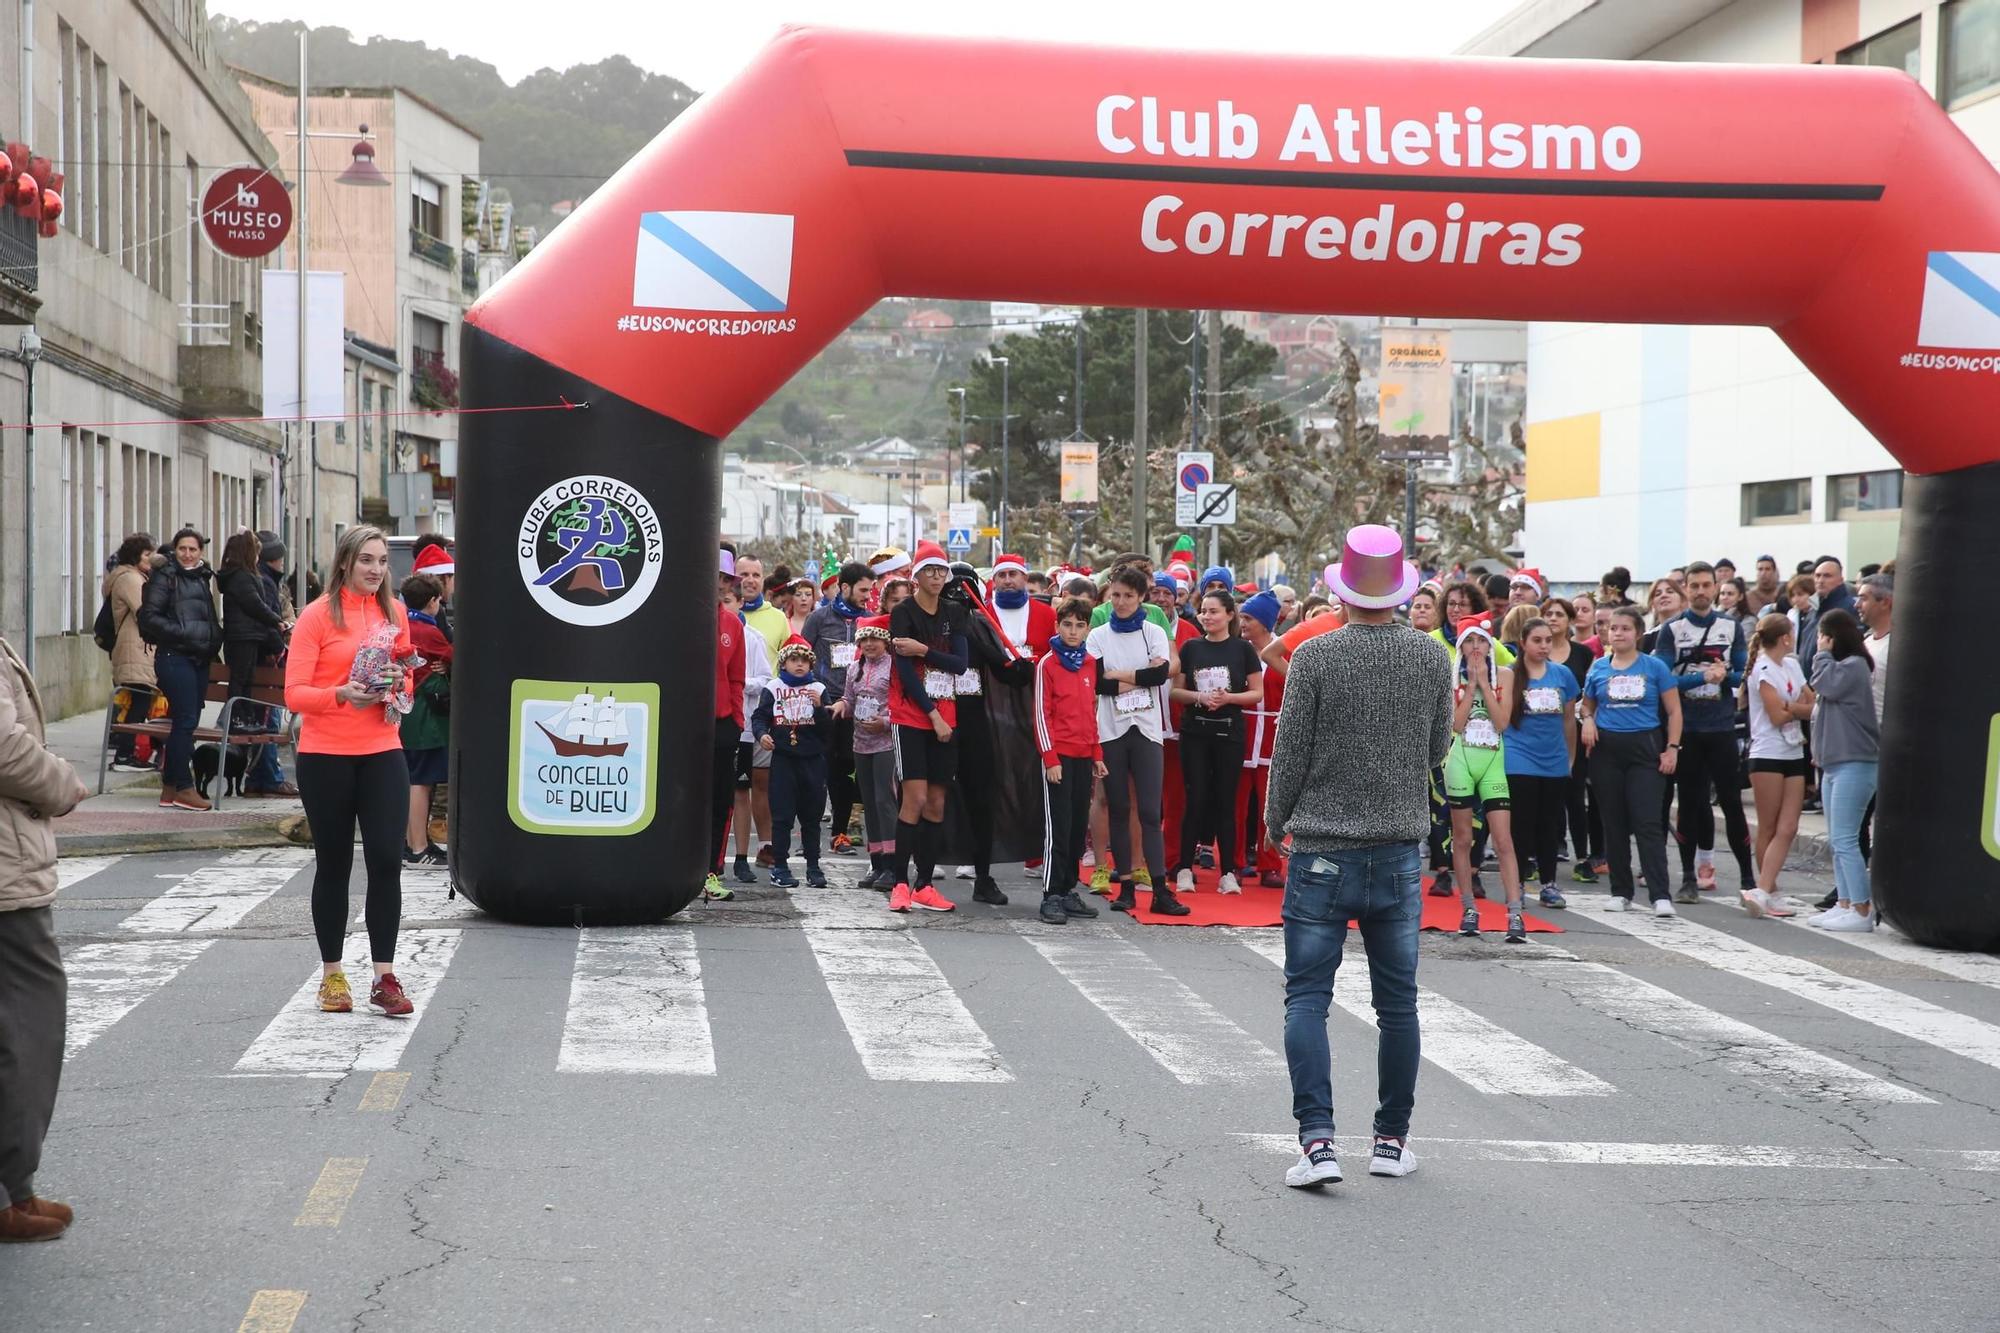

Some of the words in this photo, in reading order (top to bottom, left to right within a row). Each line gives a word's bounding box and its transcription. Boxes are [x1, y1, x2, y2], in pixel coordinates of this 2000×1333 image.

[1096, 94, 1259, 160] Club
[1278, 103, 1642, 172] Atletismo
[213, 210, 282, 228] MUSEO
[1140, 195, 1585, 267] Corredoiras
[617, 314, 797, 337] #EUSONCORREDOIRAS
[520, 495, 555, 558] CLUBE
[556, 480, 661, 564] CORREDOIRAS
[537, 764, 629, 786] CONCELLO
[546, 789, 564, 805] DE
[570, 790, 628, 813] BUEU
